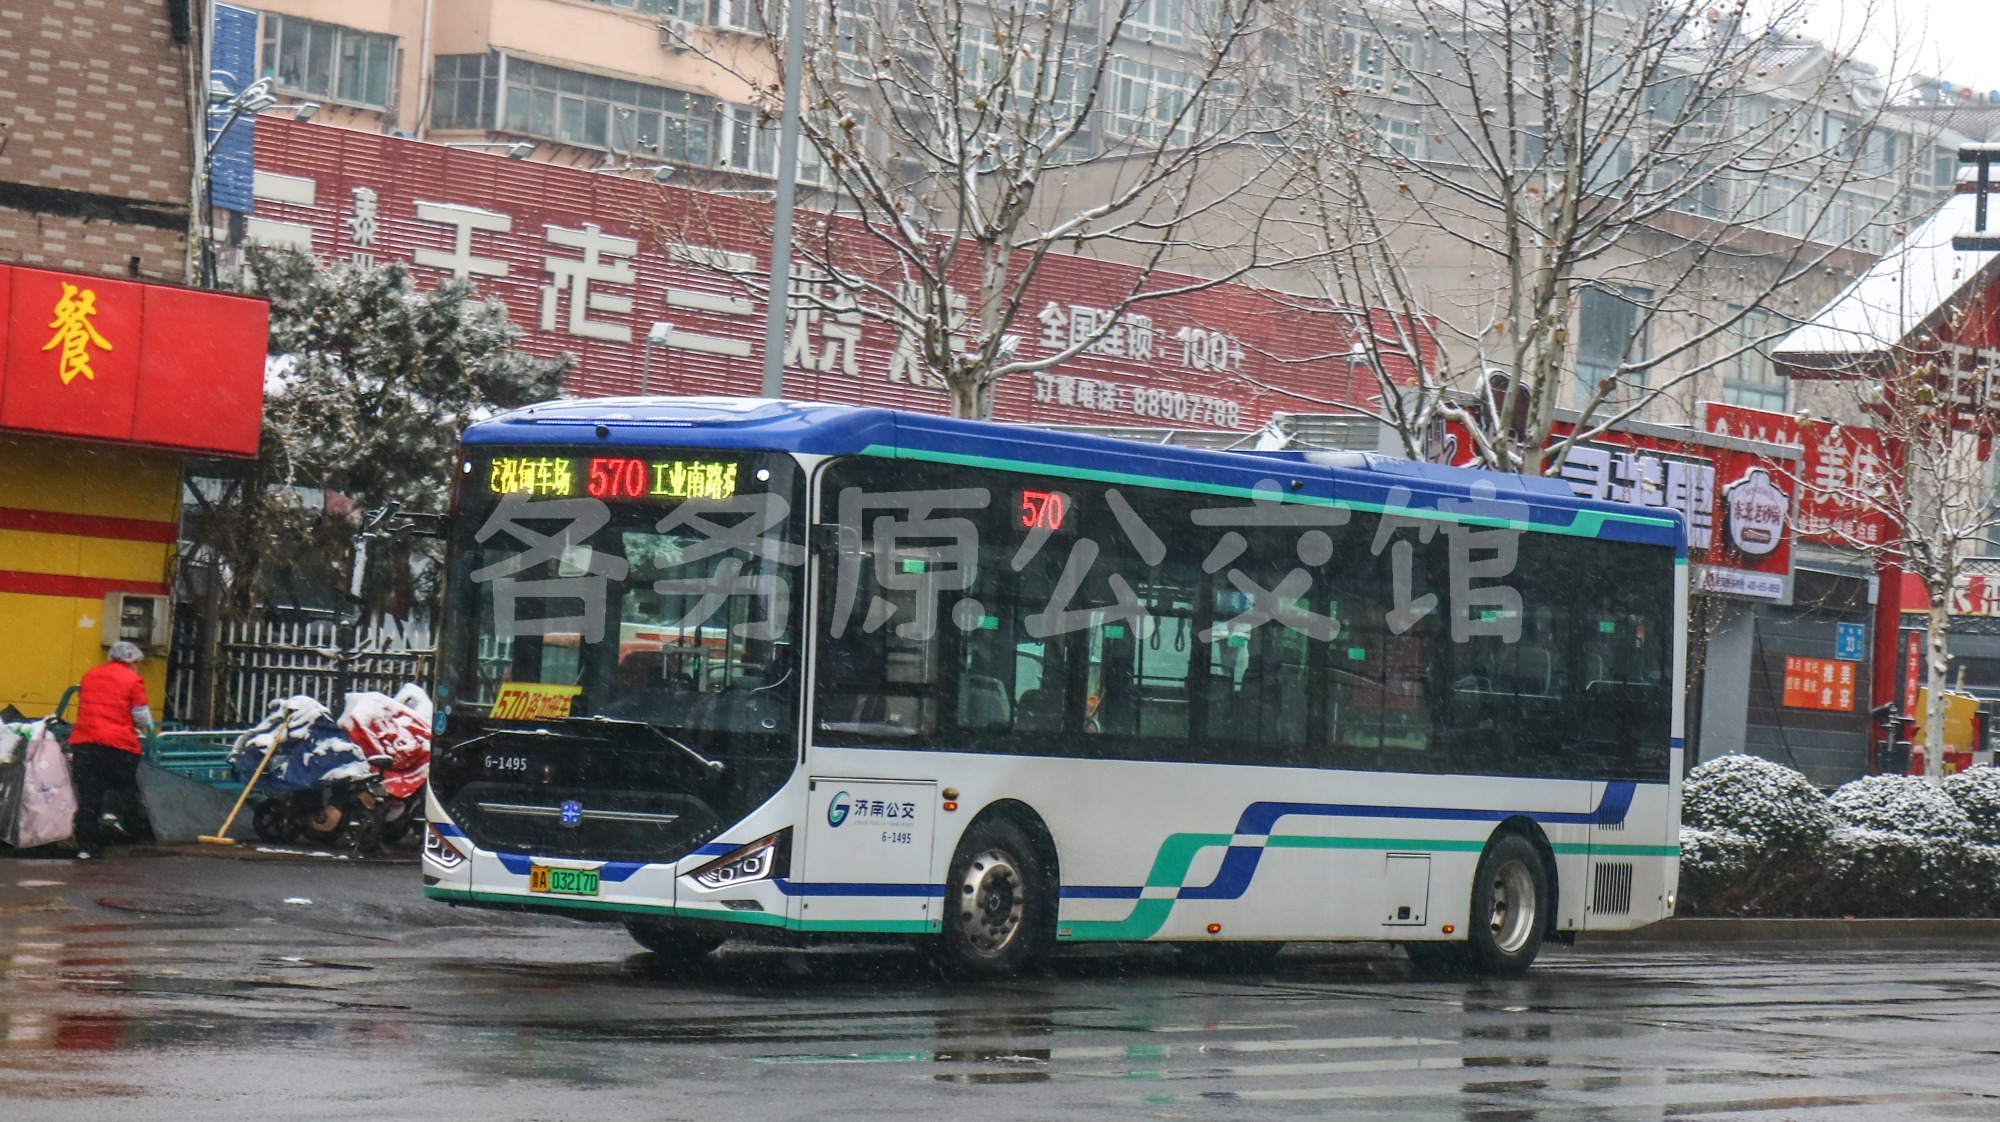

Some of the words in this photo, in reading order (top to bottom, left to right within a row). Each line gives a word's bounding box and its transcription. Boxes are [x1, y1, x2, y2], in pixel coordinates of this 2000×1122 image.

[42, 282, 113, 384] 餐
[587, 458, 647, 497] 570
[1021, 490, 1064, 531] 570
[854, 799, 915, 819] 济南公交
